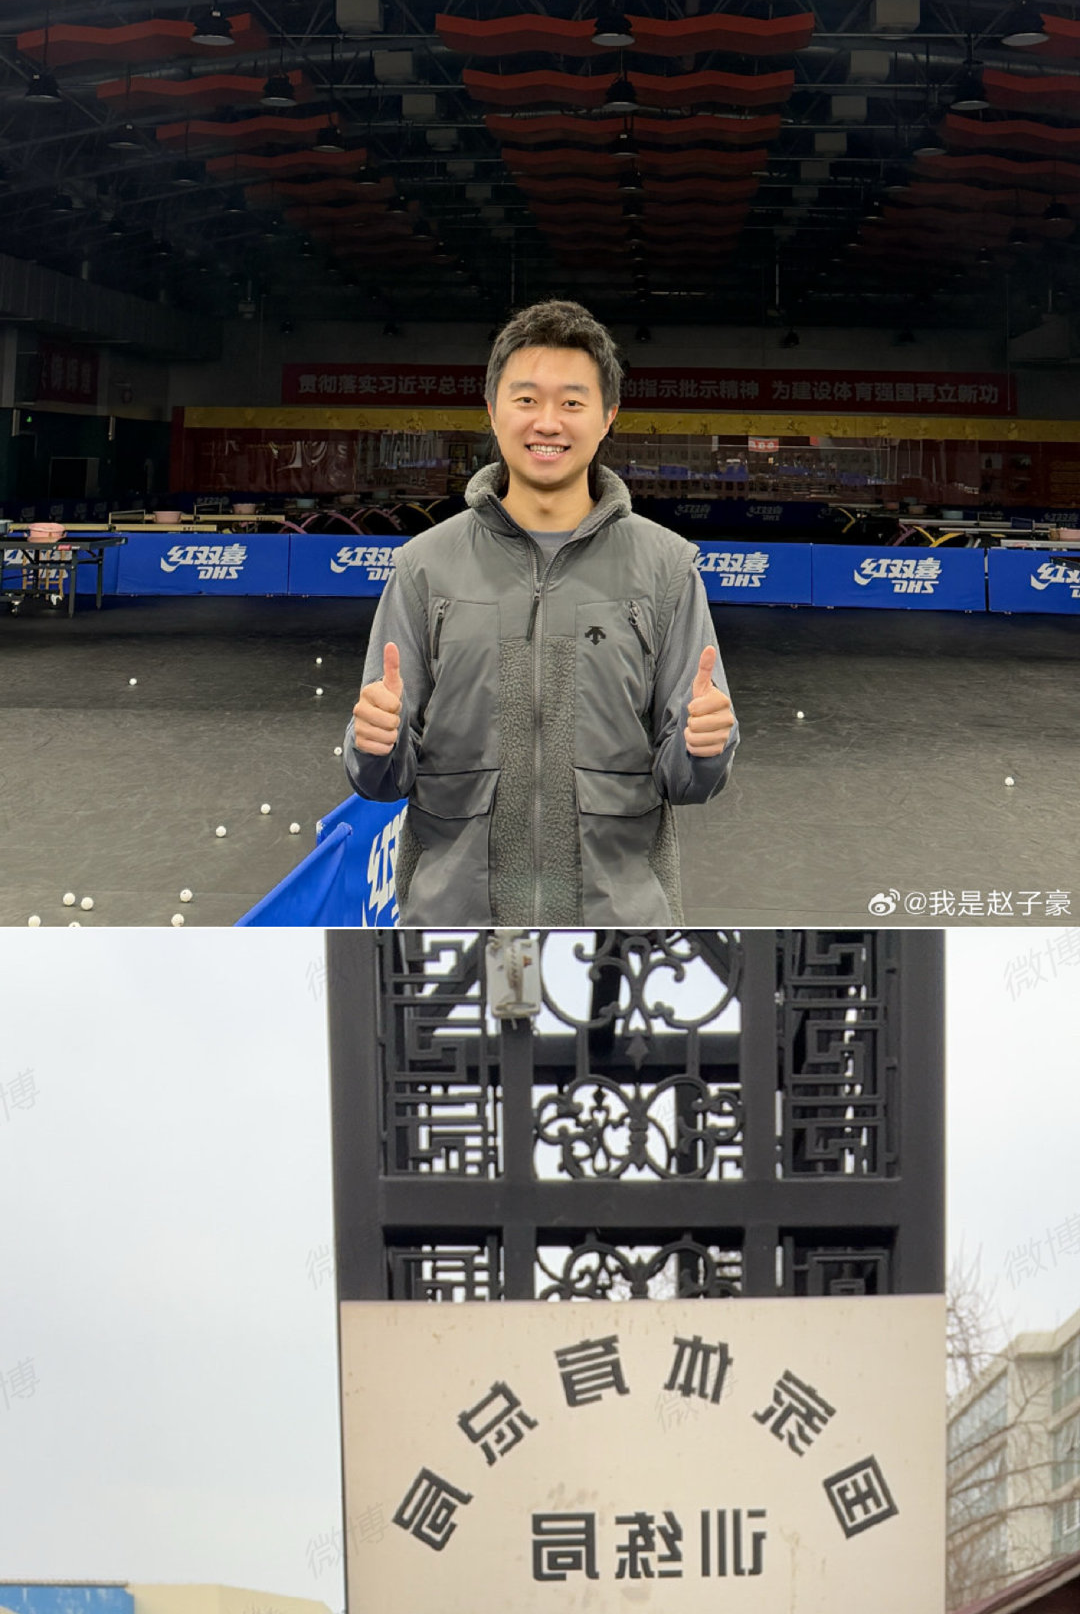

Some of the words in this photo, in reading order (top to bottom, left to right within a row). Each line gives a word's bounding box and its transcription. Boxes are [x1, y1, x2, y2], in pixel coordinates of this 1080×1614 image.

[160, 543, 247, 572] 红双喜
[330, 546, 396, 573] 红双
[197, 566, 244, 580] DHS
[366, 567, 396, 581] DH
[853, 557, 942, 586] 红双喜
[720, 573, 766, 587] DHS
[891, 579, 939, 594] DHS
